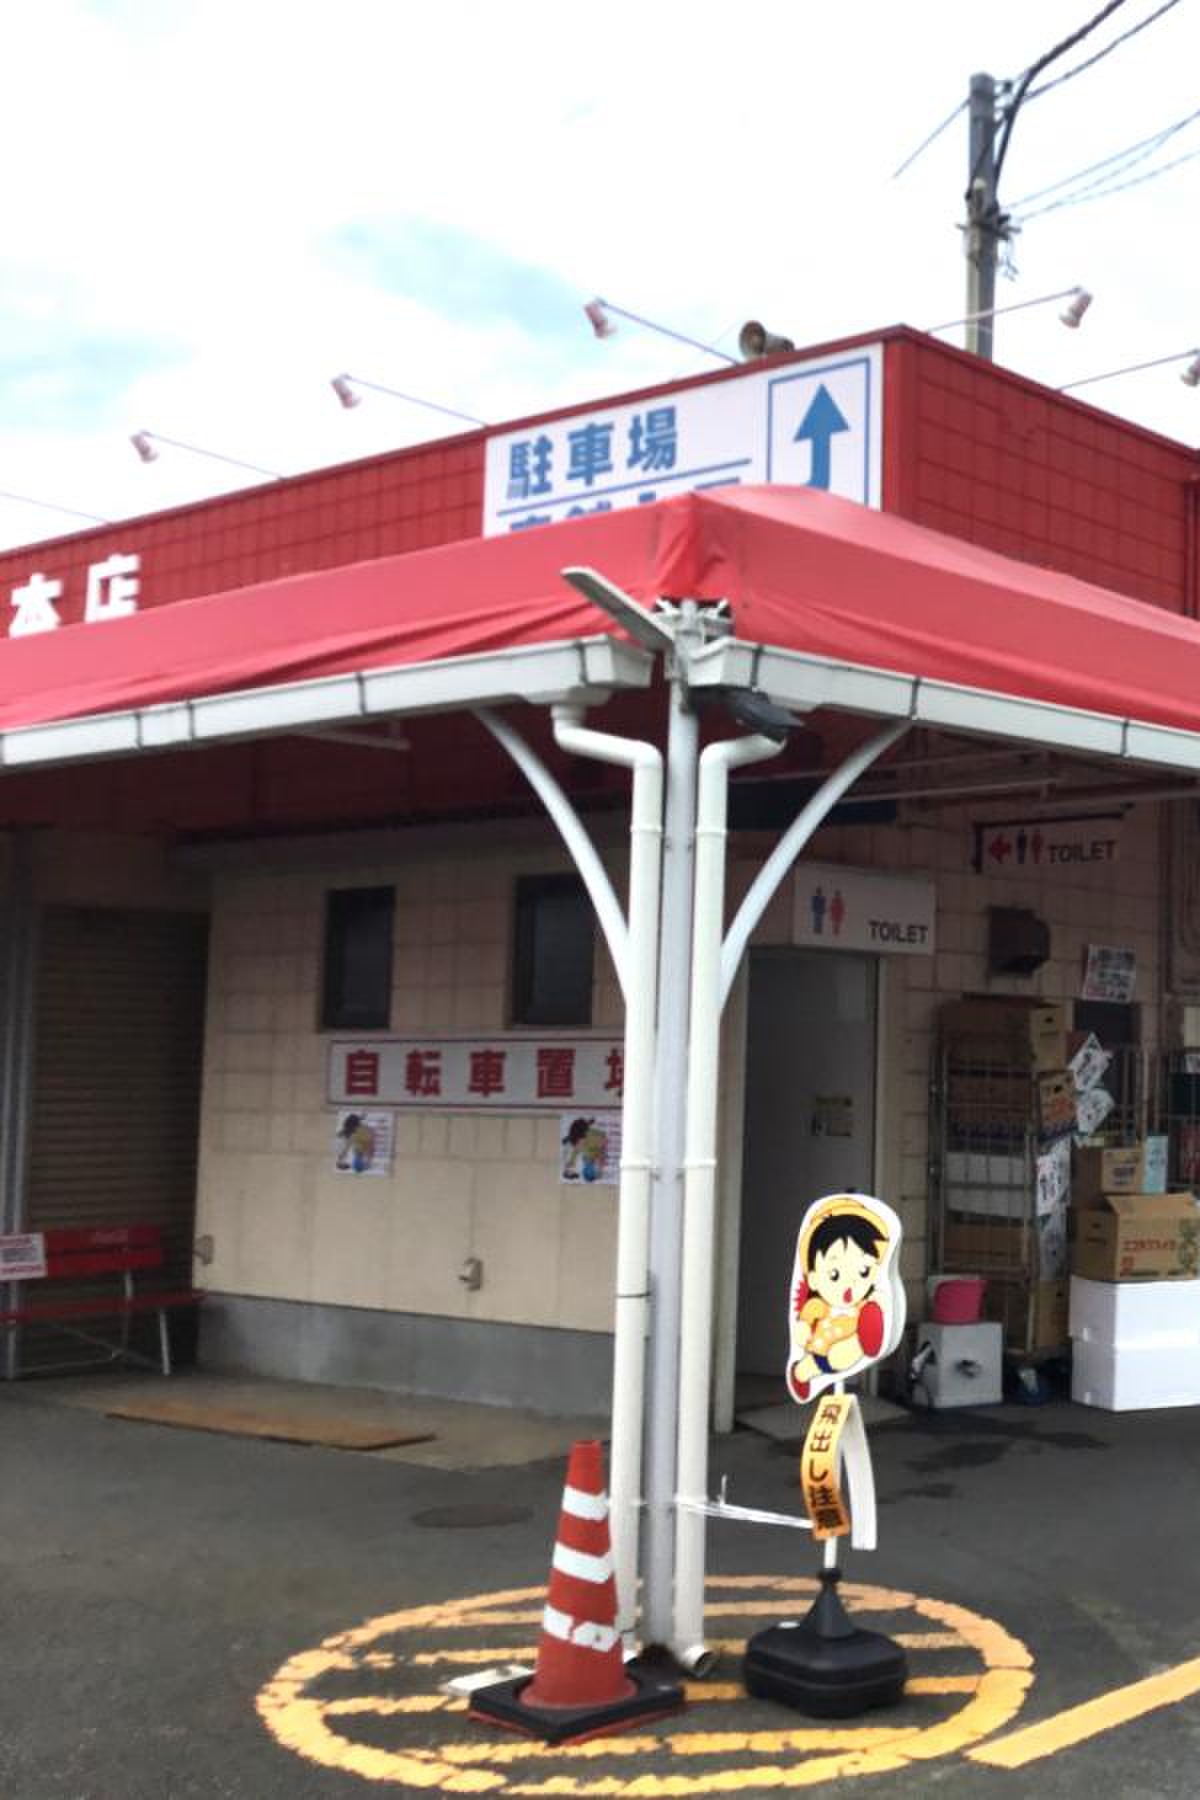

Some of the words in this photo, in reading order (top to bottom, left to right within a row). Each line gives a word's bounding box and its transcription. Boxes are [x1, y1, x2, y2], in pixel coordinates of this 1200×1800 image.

[507, 406, 677, 499] 駐車場
[1048, 839, 1118, 864] TOILET
[868, 920, 928, 944] TOILET
